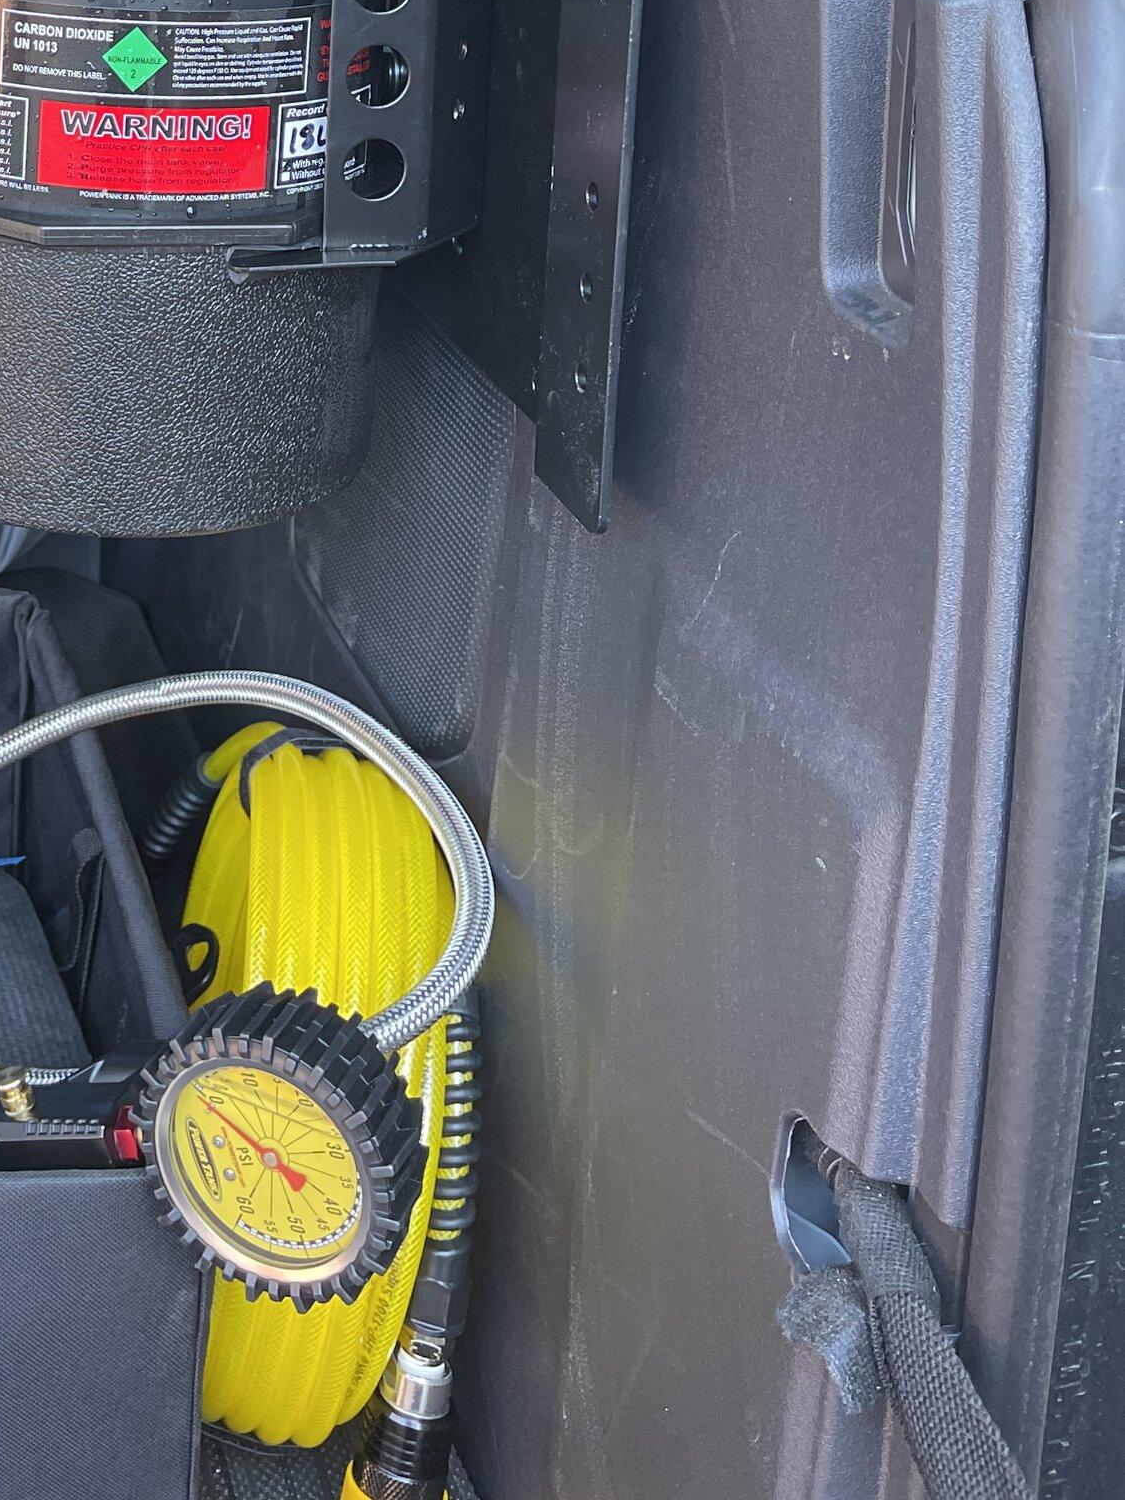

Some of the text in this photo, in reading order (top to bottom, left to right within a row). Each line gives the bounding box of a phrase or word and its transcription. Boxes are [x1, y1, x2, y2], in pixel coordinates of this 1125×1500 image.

[14, 21, 114, 42] CARBON DIOXIDE
[14, 37, 58, 54] UN 1013
[107, 55, 163, 66] NON-FLAMMABLE
[12, 62, 24, 72] DO
[24, 64, 38, 74] NOT
[38, 66, 67, 78] REMOVE
[67, 69, 83, 80] THIS
[130, 68, 137, 79] 2
[286, 103, 325, 119] Record
[60, 109, 253, 141] WARNING!
[80, 153, 114, 164] Close
[116, 155, 133, 165] the
[166, 157, 190, 166] tank
[292, 158, 311, 170] With
[80, 163, 114, 176] Purge
[117, 167, 165, 177] pressure
[167, 167, 193, 176] from
[194, 166, 241, 177] regulator
[291, 168, 322, 180] Without
[79, 172, 126, 184] Release
[128, 175, 156, 185] hose
[159, 176, 184, 185] from
[79, 190, 105, 199] POWER
[105, 191, 123, 200] TANK
[135, 193, 175, 202] TRADEMARK
[186, 193, 221, 202] ADVANCED
[240, 1071, 258, 1087] 10
[235, 1147, 254, 1167] PSI
[326, 1141, 345, 1160] 30
[338, 1175, 354, 1190] 35
[236, 1195, 255, 1216] 60
[323, 1198, 343, 1217] 40
[263, 1219, 279, 1233] 55
[286, 1211, 306, 1235] 50
[316, 1217, 331, 1232] 45
